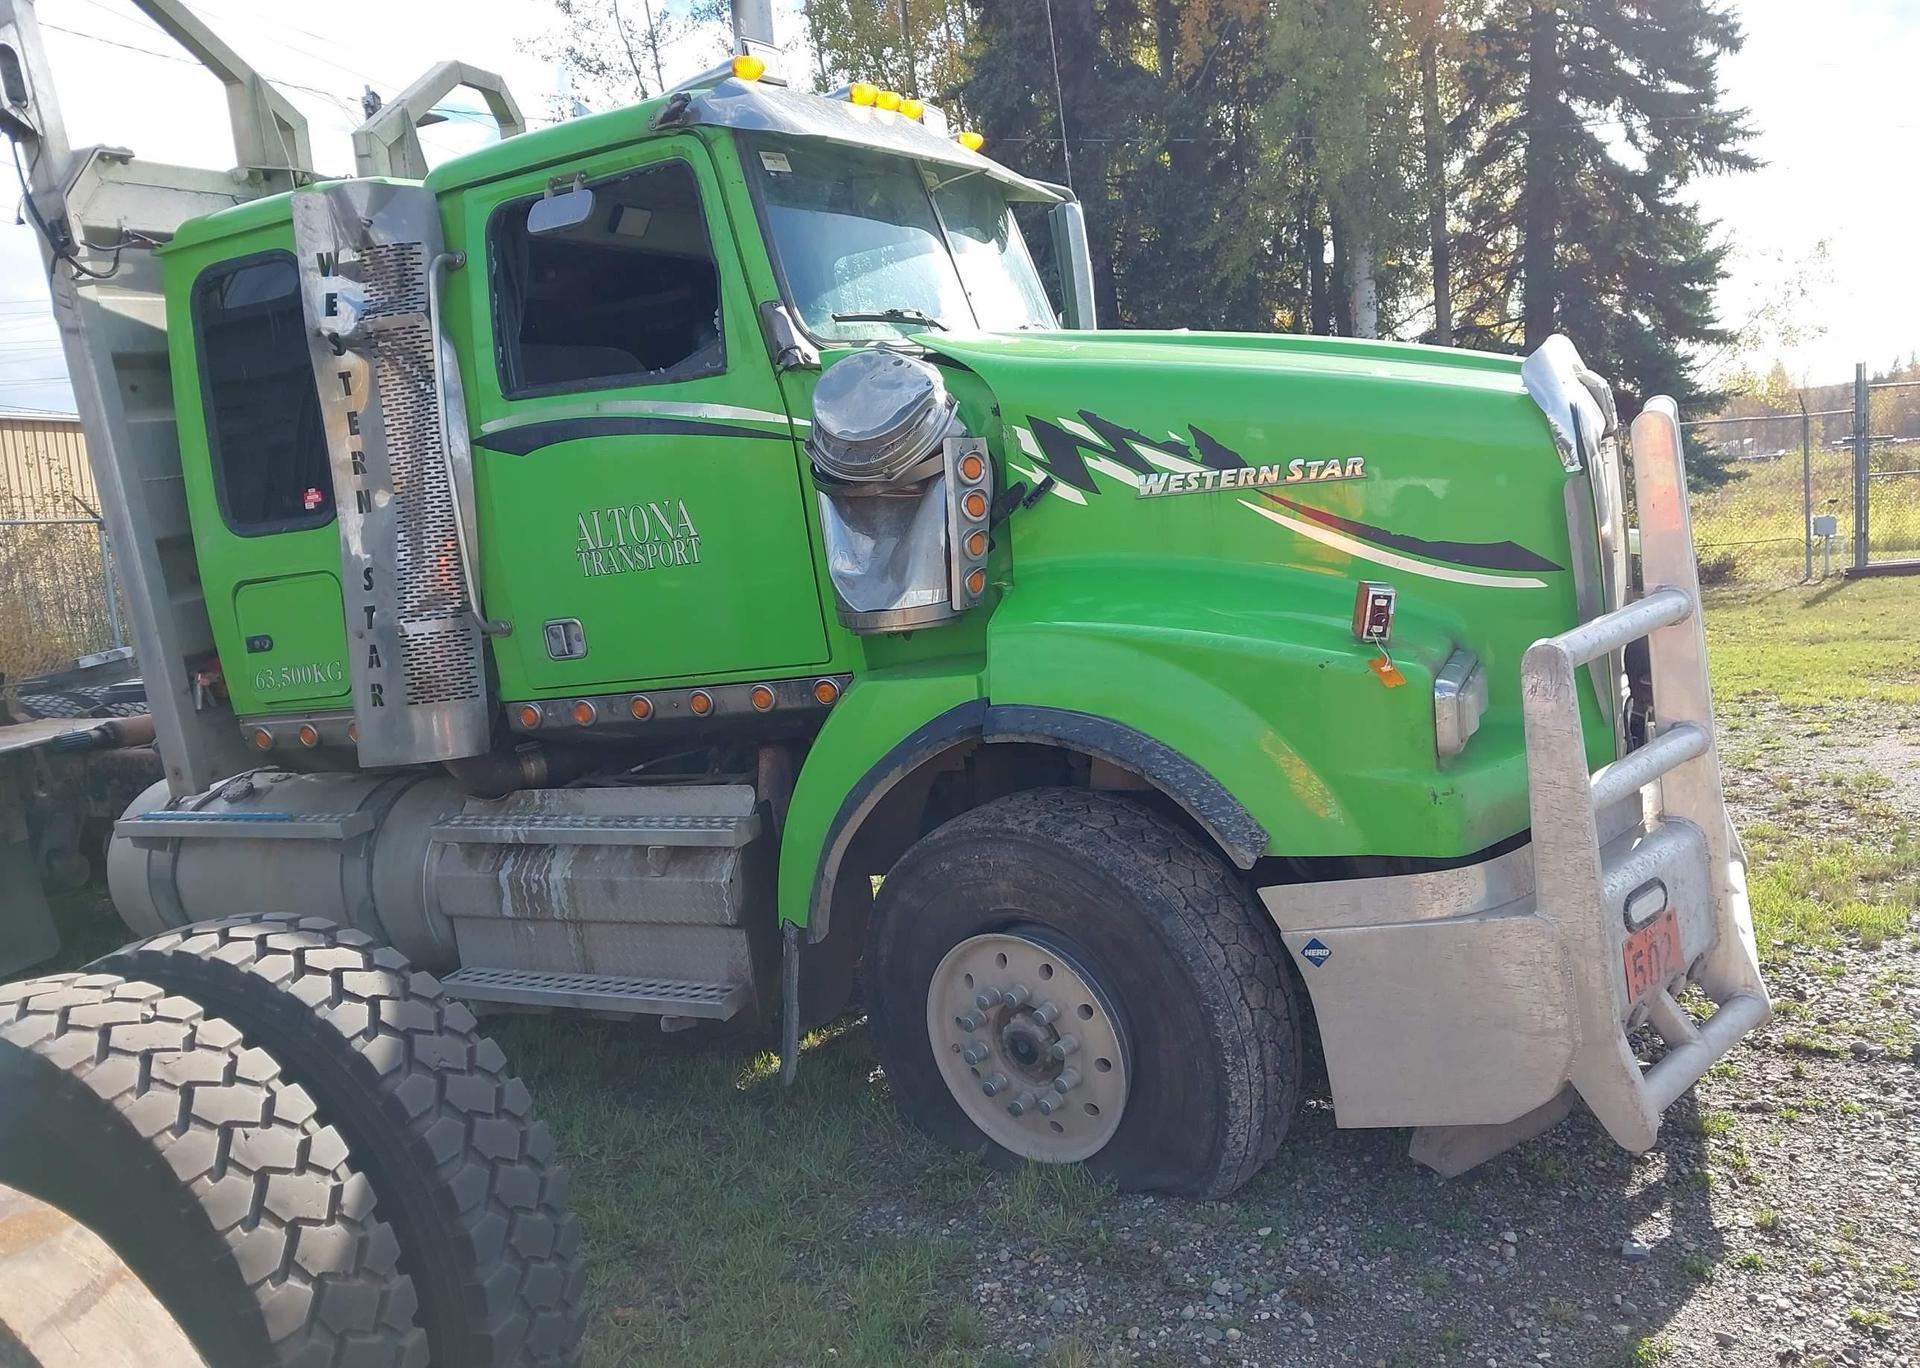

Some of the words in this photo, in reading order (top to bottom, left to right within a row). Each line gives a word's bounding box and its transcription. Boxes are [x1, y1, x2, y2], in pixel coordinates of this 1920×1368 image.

[316, 251, 373, 514] WESTERN
[363, 567, 385, 707] STAR
[1138, 464, 1280, 496] WESTERN
[1285, 456, 1366, 482] STAR
[576, 498, 699, 551] ALTONA
[577, 537, 701, 577] TRANSPORT
[255, 660, 343, 690] 63,500KG
[1304, 948, 1330, 956] HERD
